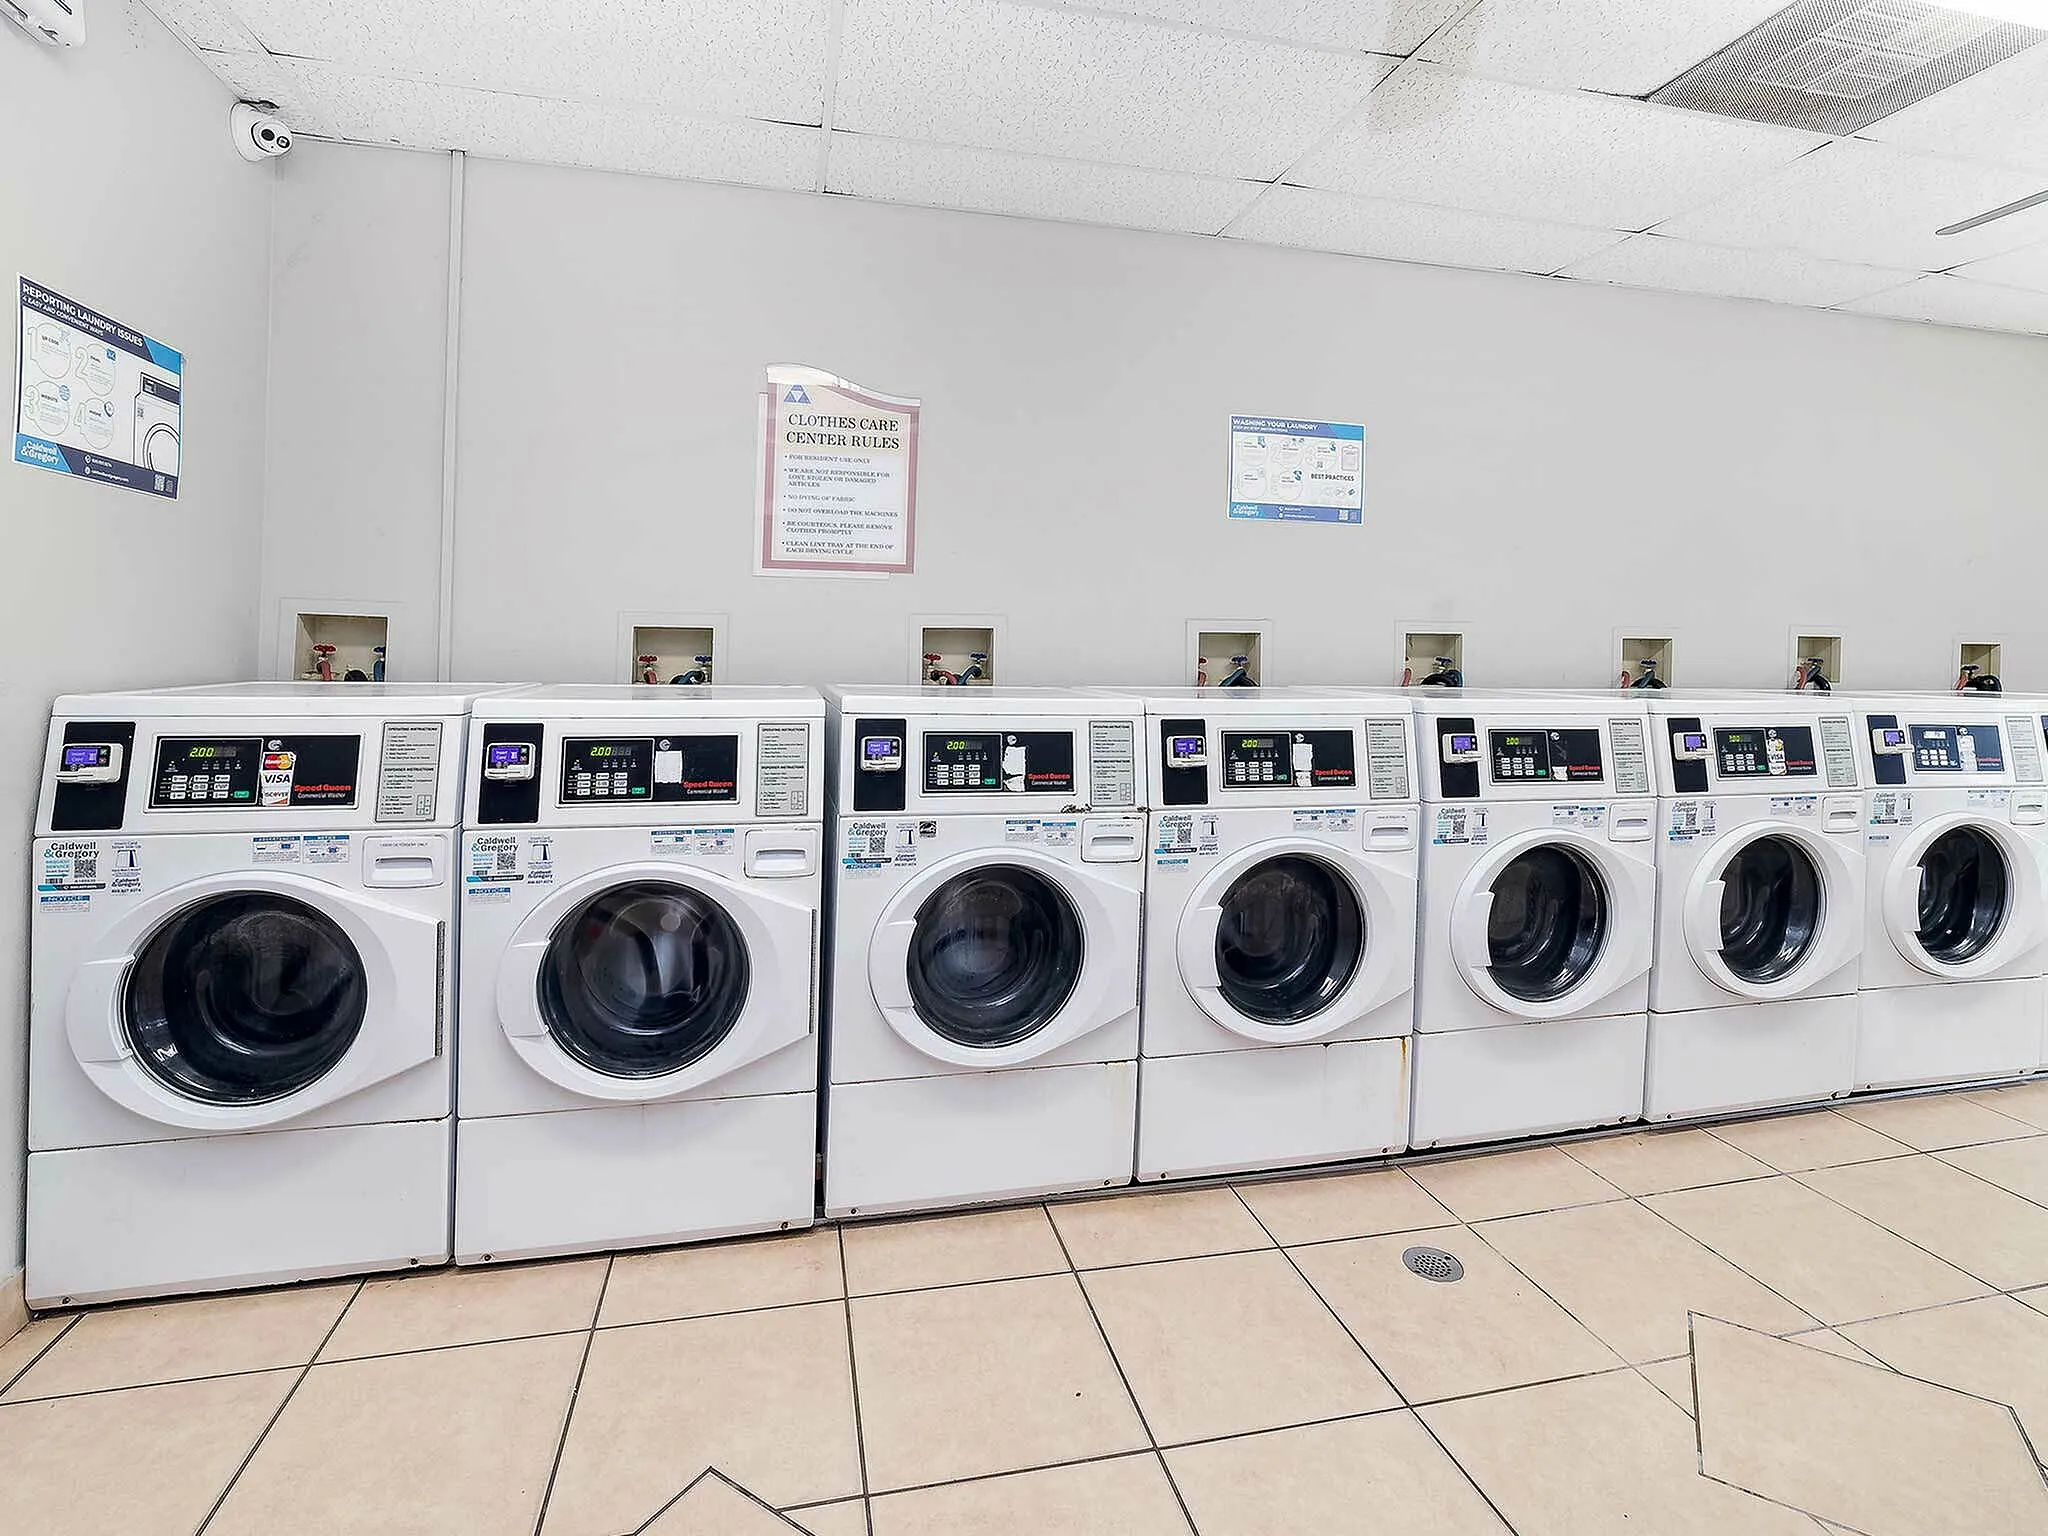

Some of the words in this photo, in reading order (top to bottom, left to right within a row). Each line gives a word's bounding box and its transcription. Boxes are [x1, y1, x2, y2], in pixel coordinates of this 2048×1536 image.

[22, 283, 76, 315] REPORTING
[77, 308, 116, 335] LAUNDRY
[117, 328, 143, 347] ISSUES
[28, 298, 41, 308] EASY
[43, 304, 56, 315] AND
[56, 309, 89, 330] CONVENIENT
[89, 326, 104, 337] WAYS
[788, 413, 856, 429] CLOTHES
[859, 418, 899, 431] CARE
[1233, 418, 1266, 426] WASHING
[1267, 420, 1286, 428] YOUR
[786, 431, 847, 446] CENTER
[852, 435, 900, 449] RULES
[25, 440, 57, 455] Caldwell
[1324, 474, 1355, 482] PRACTICES
[264, 774, 291, 784] VISA
[294, 784, 322, 792] Speed
[50, 841, 96, 850] Caldwell
[477, 836, 516, 845] Caldwell
